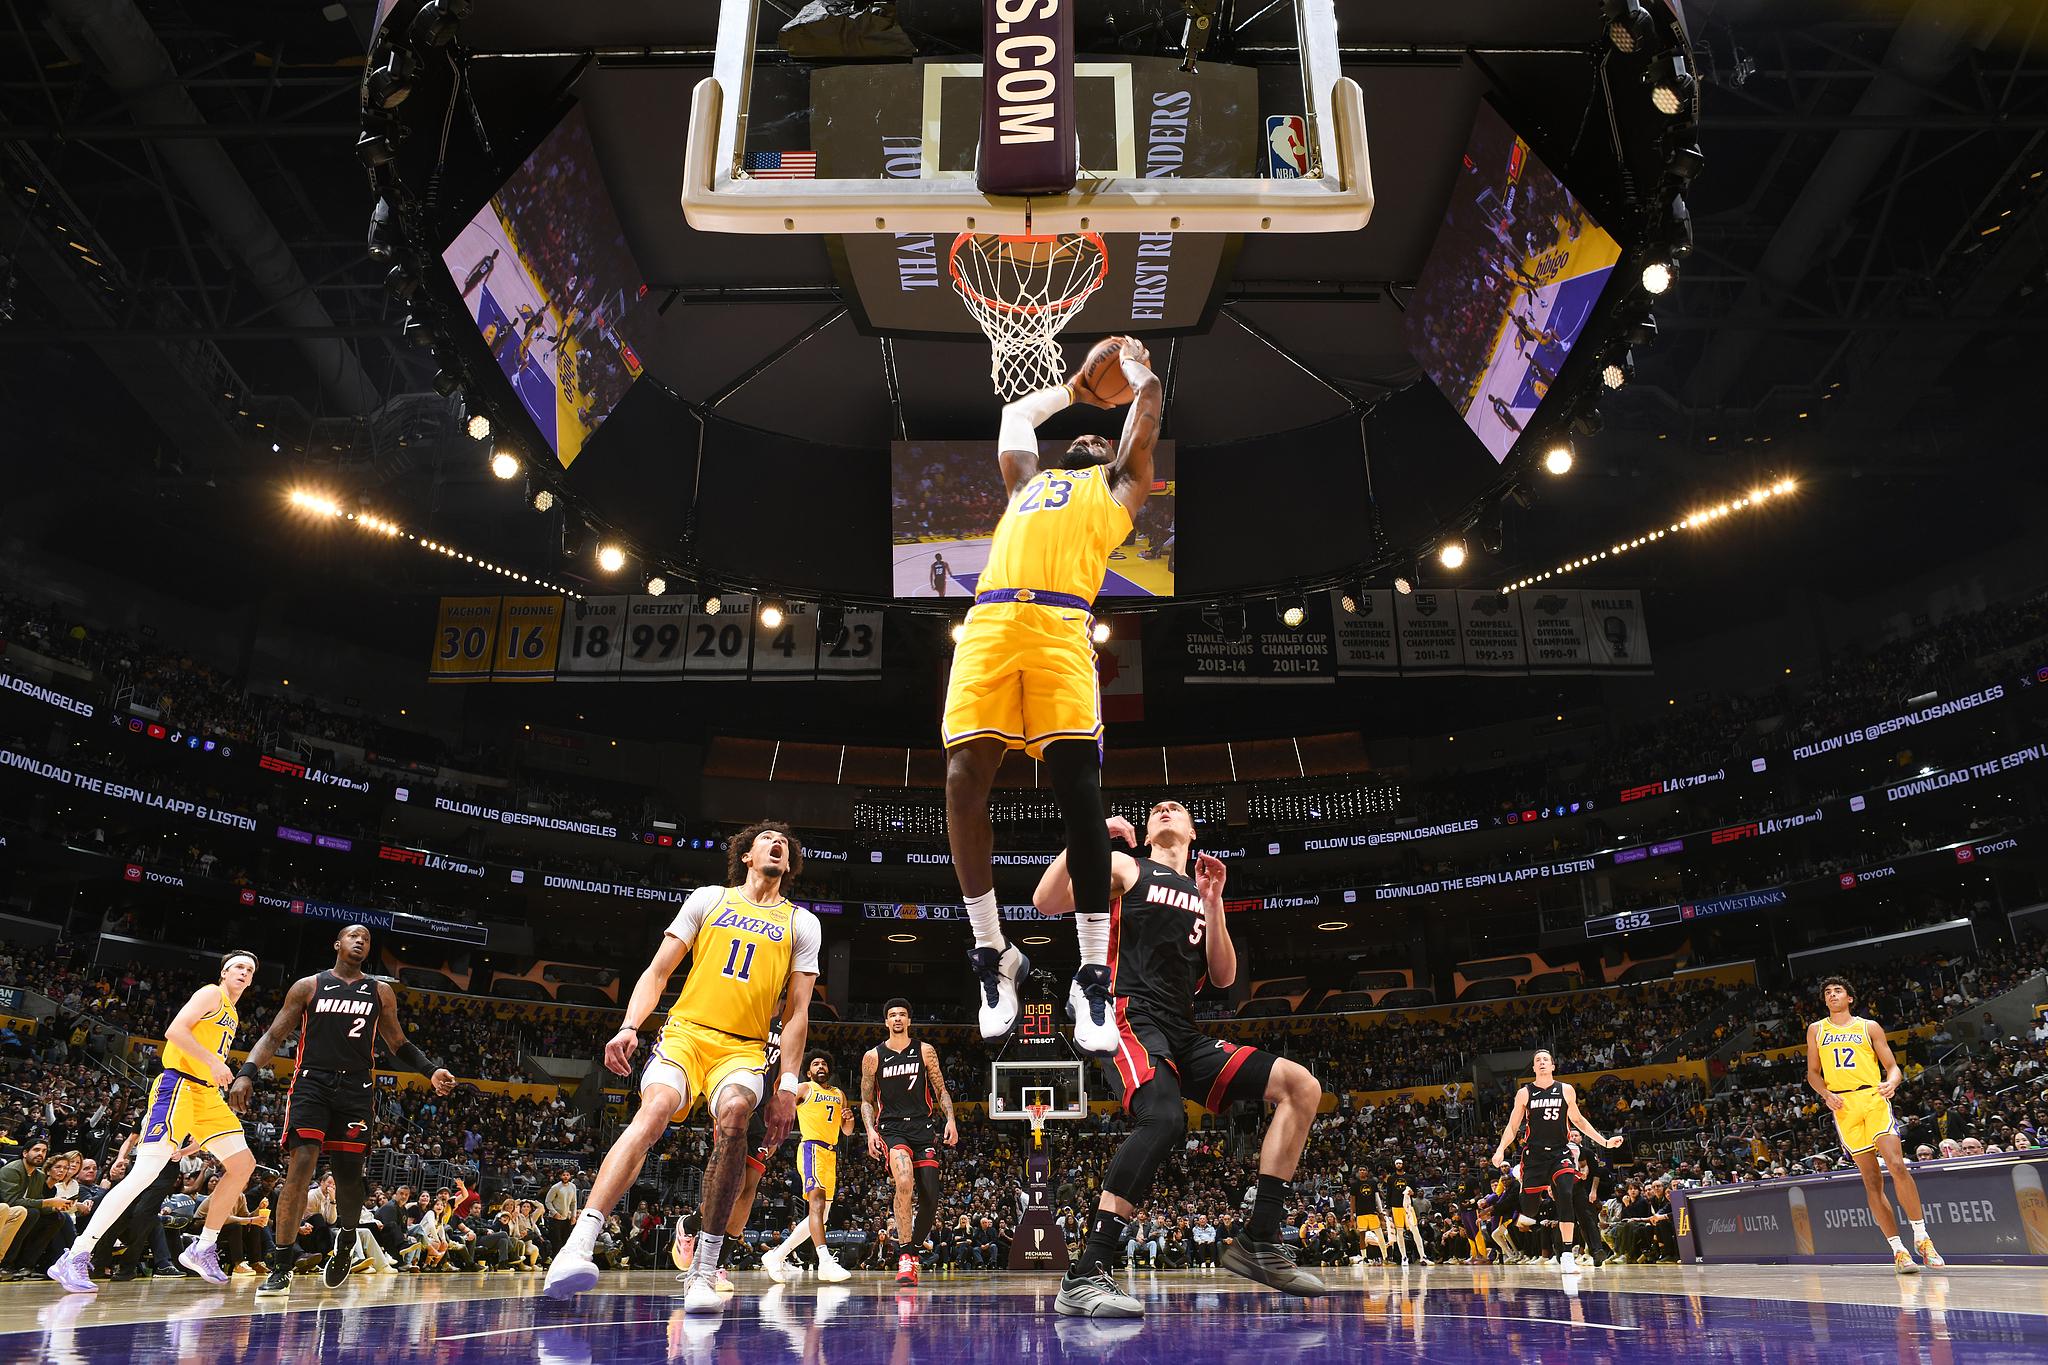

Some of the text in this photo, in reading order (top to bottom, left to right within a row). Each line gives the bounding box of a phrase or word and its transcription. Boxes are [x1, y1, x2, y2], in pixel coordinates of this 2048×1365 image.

[1276, 168, 1294, 179] NBA
[1131, 261, 1169, 320] FIRST
[1017, 479, 1075, 516] 23
[447, 606, 491, 616] VACHON
[510, 605, 554, 616] DIONNE
[583, 605, 616, 616] AYLOR
[633, 604, 684, 615] GRETZKY
[1591, 599, 1634, 610] MILLER
[1344, 621, 1384, 629] WESTERN
[1408, 620, 1448, 628] WESTERN
[1470, 621, 1512, 629] CAMPBELL
[1185, 634, 1224, 643] STANLE
[1260, 634, 1327, 643] STANLEY CUP
[1338, 630, 1391, 638] CONFERENCE
[1402, 629, 1456, 638] CONFERENCE
[1465, 629, 1519, 638] CONFERENCE
[1537, 628, 1574, 637] DIVISION
[440, 626, 487, 660] 30
[507, 626, 545, 658] 16
[572, 625, 609, 658] 18
[632, 624, 680, 658] 99
[693, 624, 743, 657] 20
[772, 624, 796, 657] 4
[1342, 639, 1390, 647] CHAMPIONS
[1406, 639, 1455, 647] CHAMPIONS
[1469, 639, 1517, 647] CHAMPIONS
[1532, 638, 1581, 646] CHAMPIONS
[1187, 644, 1254, 655] CHAMPIONS
[1261, 644, 1328, 655] CHAMPIONS
[1349, 650, 1385, 660] 2013-14
[1415, 650, 1450, 660] 2011-12
[1475, 650, 1514, 660] 1992-93
[1539, 650, 1577, 659] 1990-91
[1197, 658, 1247, 672] 2013-14
[1273, 659, 1320, 672] 2011-12
[1793, 684, 2004, 760] FOLLOW US @ESPNLOSANGELES
[258, 754, 306, 779] ESPN
[304, 767, 321, 783] LA
[329, 774, 352, 788] 710
[1887, 747, 2040, 802] DOWNLOAD THE ESPN
[1620, 781, 1663, 804] ESPN
[1663, 778, 1679, 792] LA
[1686, 773, 1706, 787] 710
[73, 772, 102, 793] THE
[103, 782, 144, 803] ESPN
[146, 791, 164, 809] LA
[164, 797, 195, 816] APP
[196, 805, 207, 819] &
[208, 808, 257, 832] LISTEN
[435, 797, 617, 838] FOLLOW US @ESPNLOSANGELES
[1304, 819, 1479, 851] FOLLOW US @ESPNLOSANGELES
[1711, 823, 1759, 845] ESPN
[1759, 820, 1776, 835] LA
[1783, 814, 1804, 829] 710
[1211, 849, 1229, 858] 710
[1975, 838, 2018, 855] TOYOTA
[378, 845, 426, 866] ESPN
[424, 854, 440, 869] LA
[447, 861, 468, 873] 710
[814, 850, 832, 859] 710
[906, 853, 949, 864] FOLLOW
[145, 871, 184, 887] TOYOTA
[1375, 858, 1596, 900] DOWNLOAD THE ESPN LA APP & LISTEN
[1857, 866, 1895, 883] TOYOTA
[543, 875, 610, 895] DOWNLOAD
[612, 884, 634, 898] THE
[635, 887, 667, 902] ESPN
[667, 891, 682, 903] LA
[258, 894, 291, 908] TOYOTA
[1146, 884, 1206, 915] MIAM
[1223, 897, 1264, 912] ESPN
[1263, 896, 1278, 909] LA
[1284, 896, 1303, 907] 710
[870, 909, 876, 917] 3
[884, 909, 890, 917] 0
[894, 904, 927, 919] LAKERS
[933, 907, 949, 918] 90
[711, 907, 785, 942] LAKERS
[1615, 913, 1651, 931] 8:52
[721, 938, 756, 984] 11
[315, 997, 373, 1017] MIAMI
[1025, 1003, 1052, 1015] 10:09
[348, 1017, 366, 1038] 2
[1023, 1015, 1050, 1035] 20
[1821, 1032, 1863, 1046] LAKERS
[1833, 1047, 1855, 1069] 12
[883, 1062, 919, 1078] MIAMI
[379, 1076, 394, 1085] 114
[907, 1075, 918, 1090] 7
[607, 1095, 622, 1103] 115
[814, 1093, 841, 1104] LAKERS
[1530, 1098, 1562, 1109] MIAMI
[826, 1105, 834, 1121] 7
[1543, 1108, 1560, 1121] 55
[1678, 1207, 1690, 1236] LA
[1824, 1201, 1996, 1230] SUPERI LHT BEER
[1706, 1215, 1736, 1235] Michelob
[1743, 1215, 1779, 1232] ULTRA
